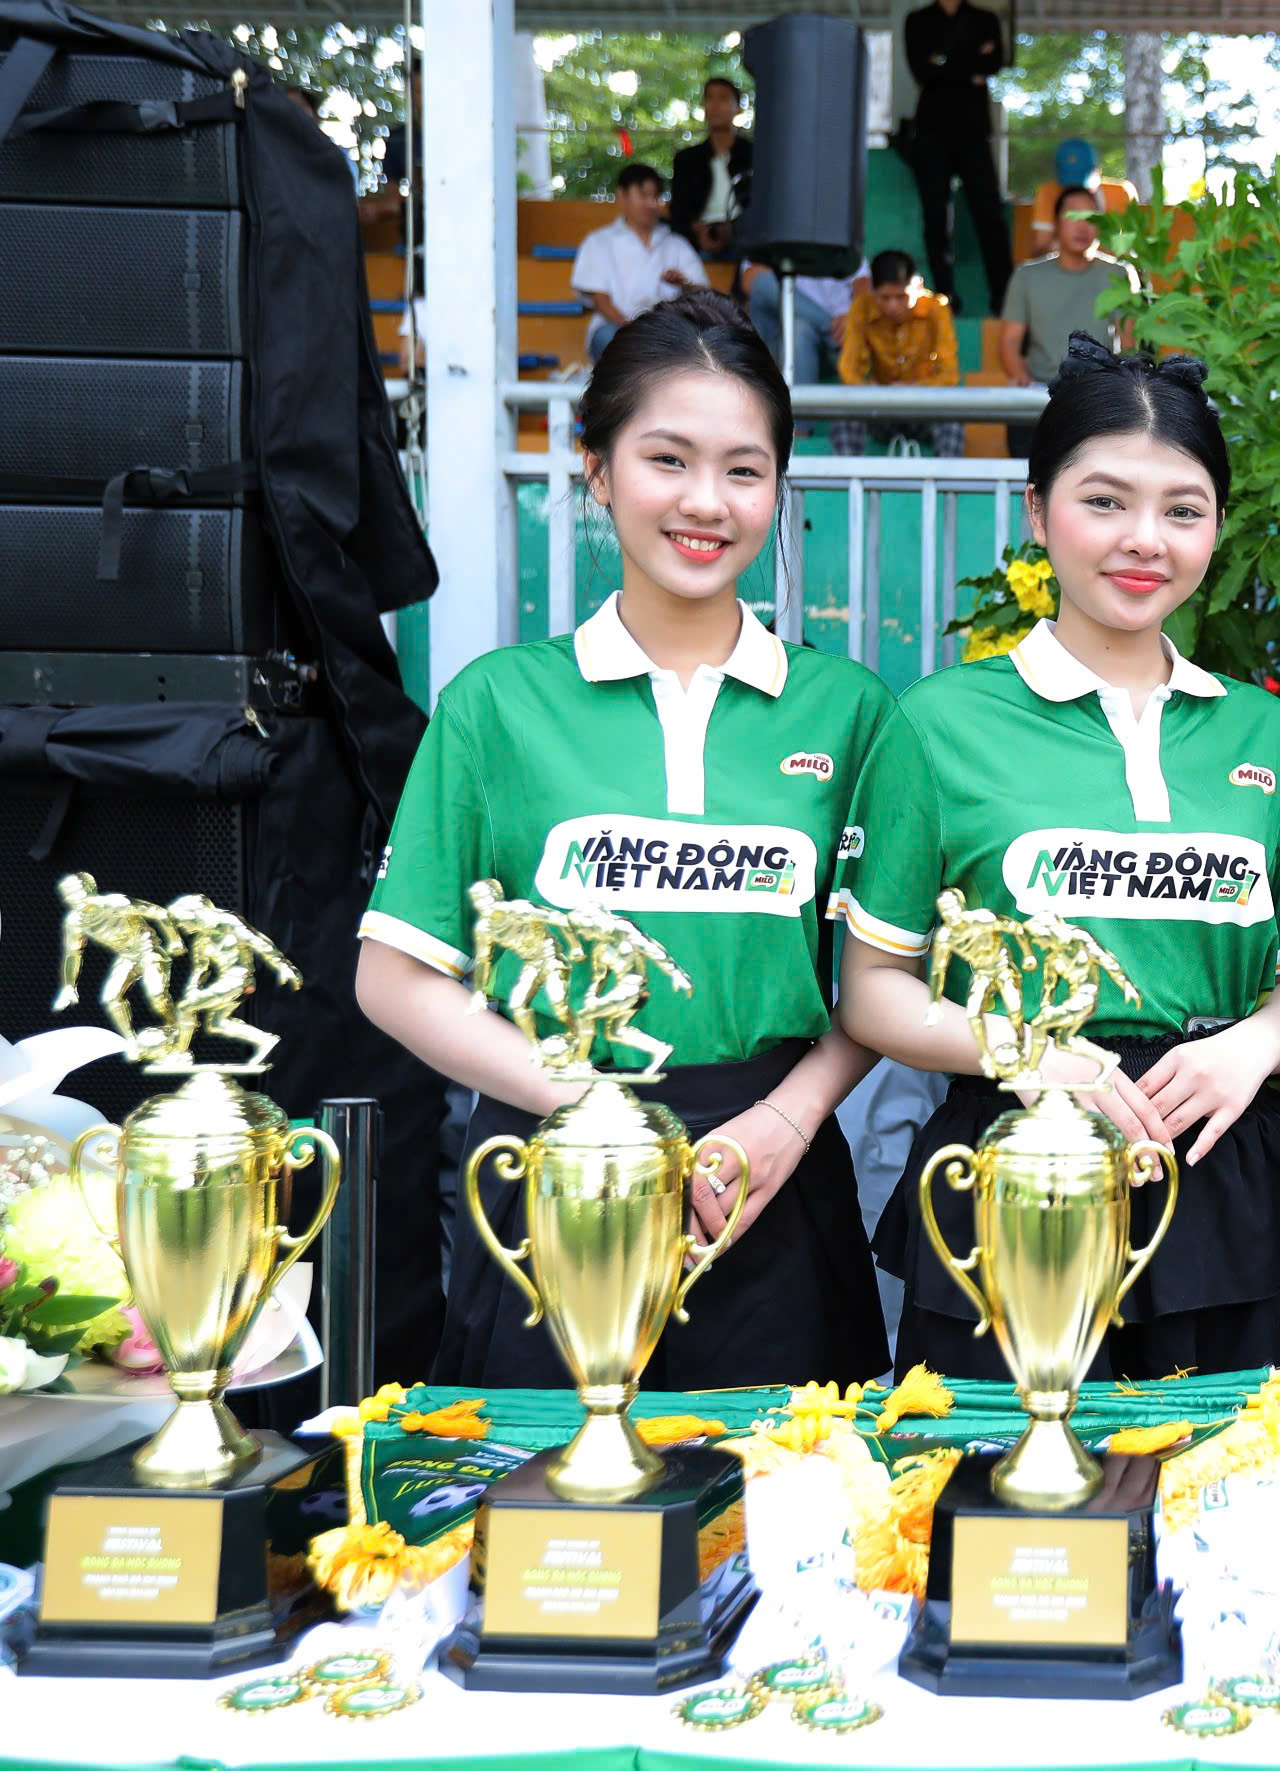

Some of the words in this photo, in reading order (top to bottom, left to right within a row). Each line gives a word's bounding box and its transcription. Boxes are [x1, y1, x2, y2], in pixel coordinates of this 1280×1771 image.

[790, 758, 829, 774] MILO
[1238, 769, 1273, 787] MILO
[560, 829, 669, 879] NĂNG
[1026, 841, 1138, 889] NĂNG
[575, 852, 652, 892] VIỆT
[656, 866, 746, 891] NAM
[753, 875, 774, 885] MILO
[1041, 865, 1122, 899] VIỆT
[1127, 875, 1213, 901] NAM
[1218, 886, 1236, 895] MILO
